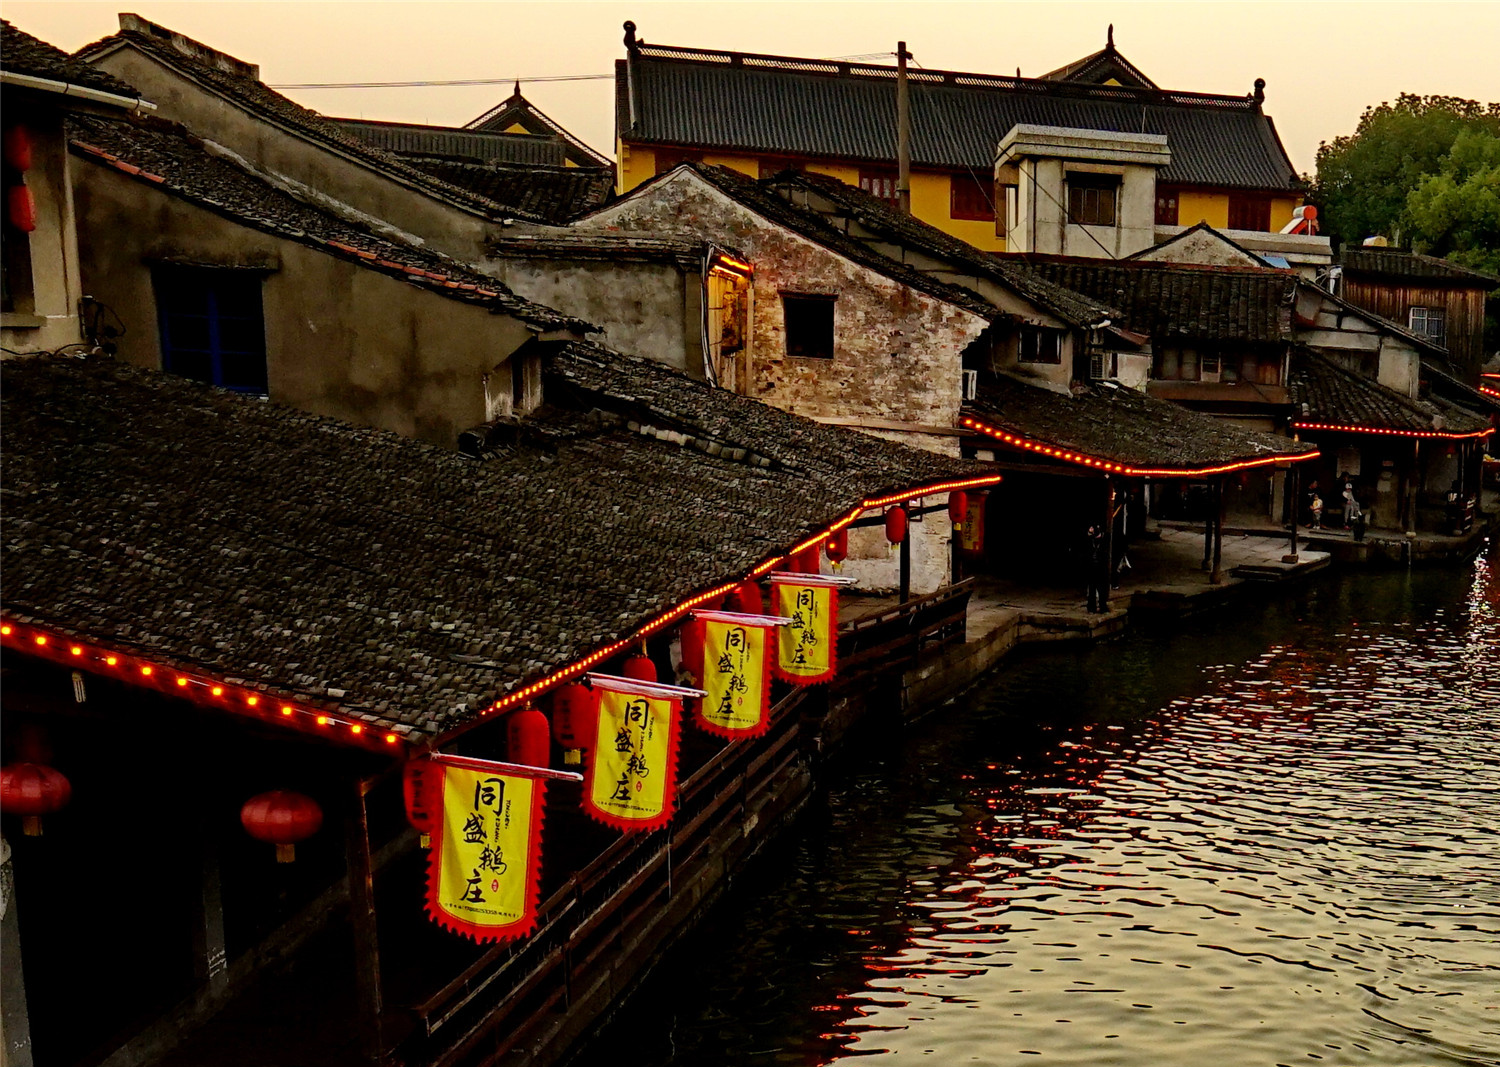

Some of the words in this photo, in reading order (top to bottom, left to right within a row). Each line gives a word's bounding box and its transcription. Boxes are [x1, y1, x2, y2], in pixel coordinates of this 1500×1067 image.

[717, 627, 749, 714] 同盛鹅庄
[791, 588, 818, 665] 同盛鹅庄
[610, 698, 650, 801] 同盛鹅庄
[459, 777, 508, 903] 同盛鹅庄
